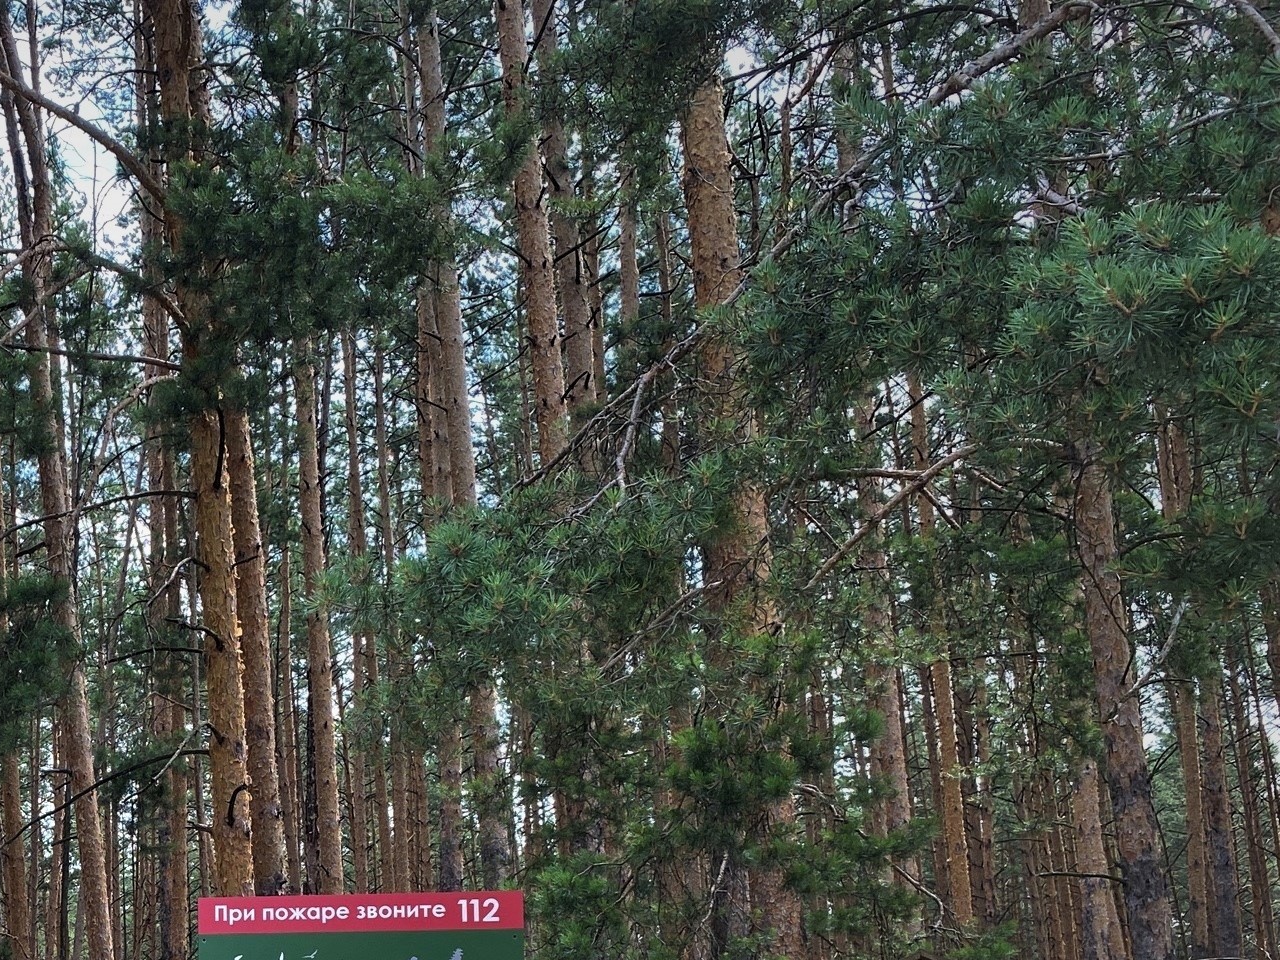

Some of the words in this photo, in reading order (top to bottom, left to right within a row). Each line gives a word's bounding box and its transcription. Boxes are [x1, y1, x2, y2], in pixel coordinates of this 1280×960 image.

[214, 905, 255, 925] При
[262, 903, 350, 924] пожаре
[357, 903, 446, 919] звоните
[458, 898, 500, 923] 112
